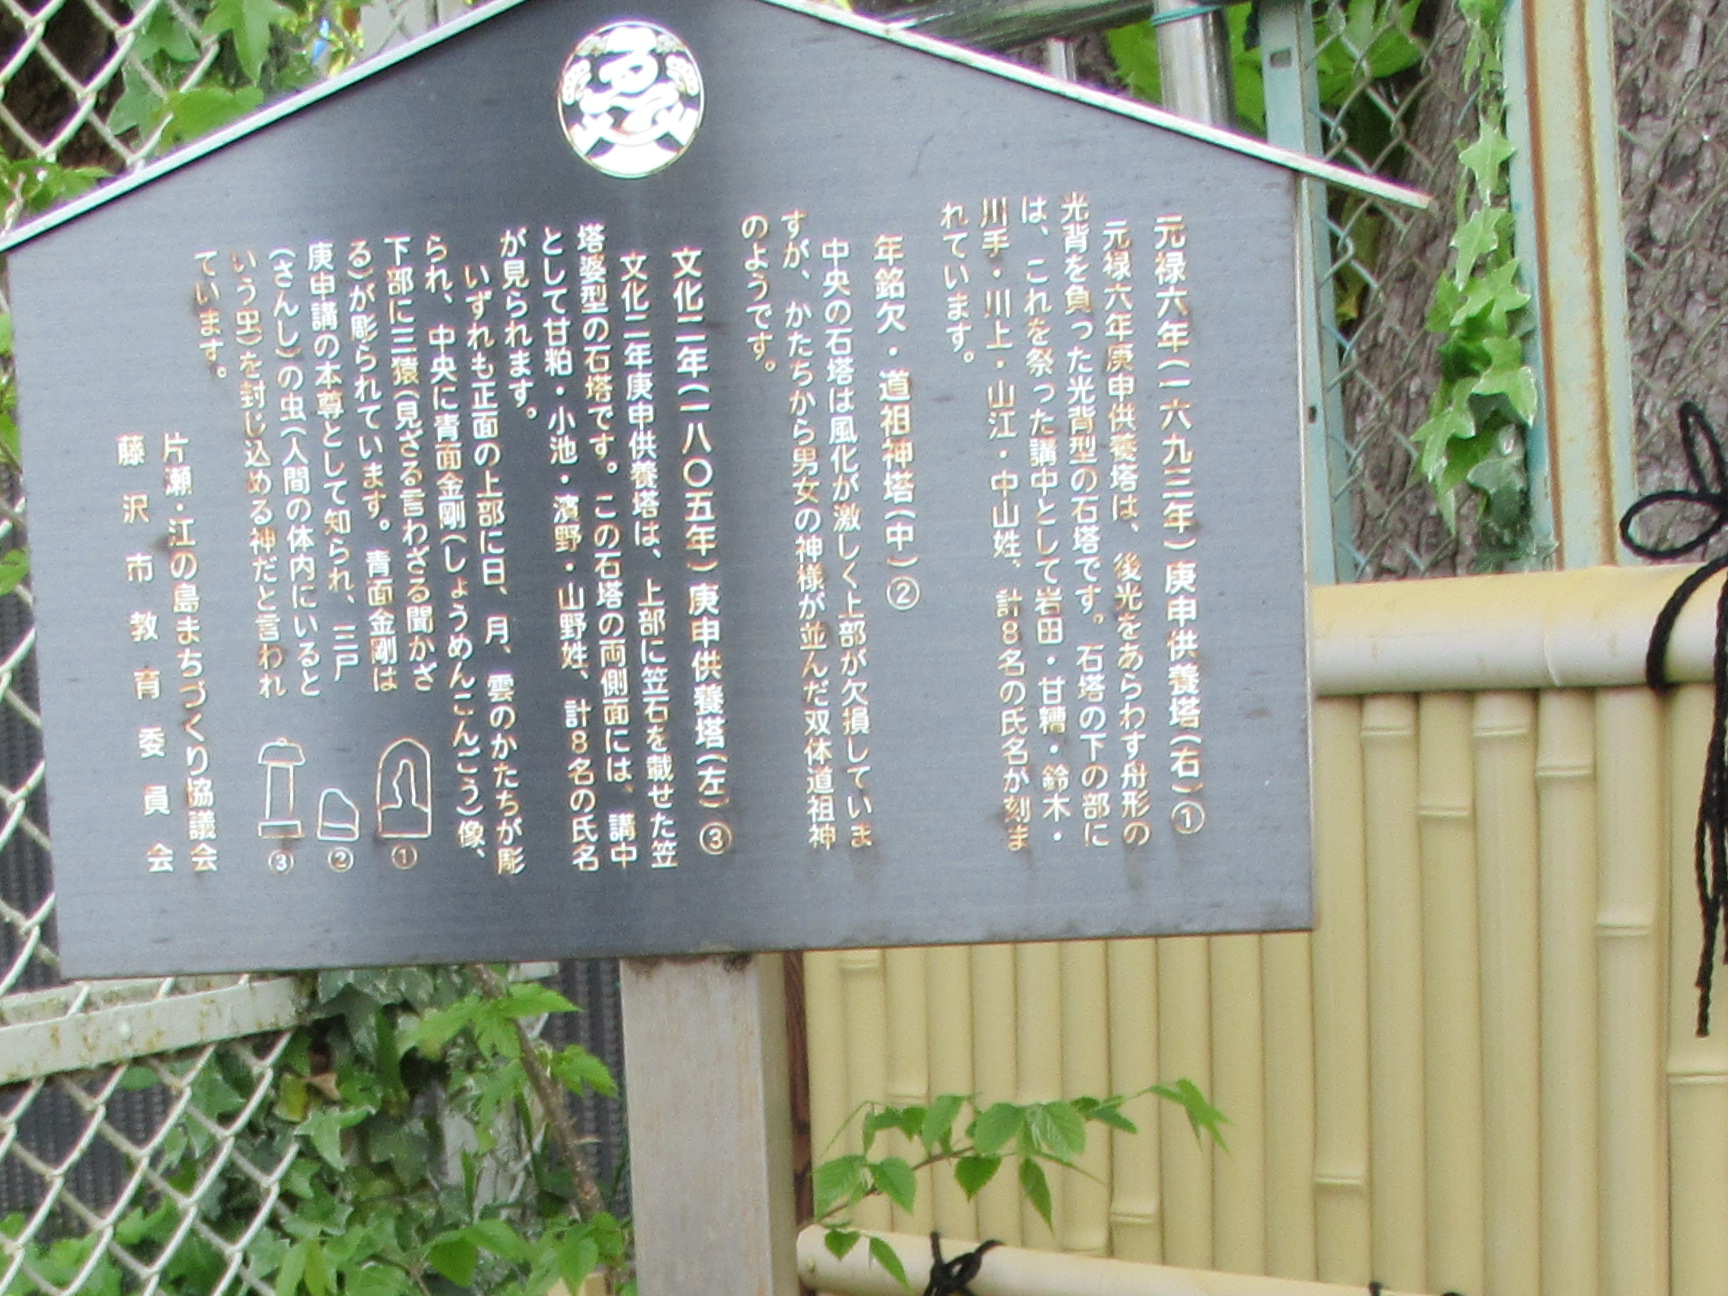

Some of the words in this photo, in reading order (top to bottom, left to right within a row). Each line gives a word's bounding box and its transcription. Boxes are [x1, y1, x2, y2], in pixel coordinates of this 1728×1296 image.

[194, 250, 227, 378] ています。
[499, 226, 538, 420] が見られます。
[741, 214, 776, 372] のようです。
[940, 202, 974, 363] れています。
[821, 237, 872, 849] 中央の石塔は風化が激しく上部が欠損していま
[162, 432, 218, 872] 片瀬・江の島まちづくり協議会
